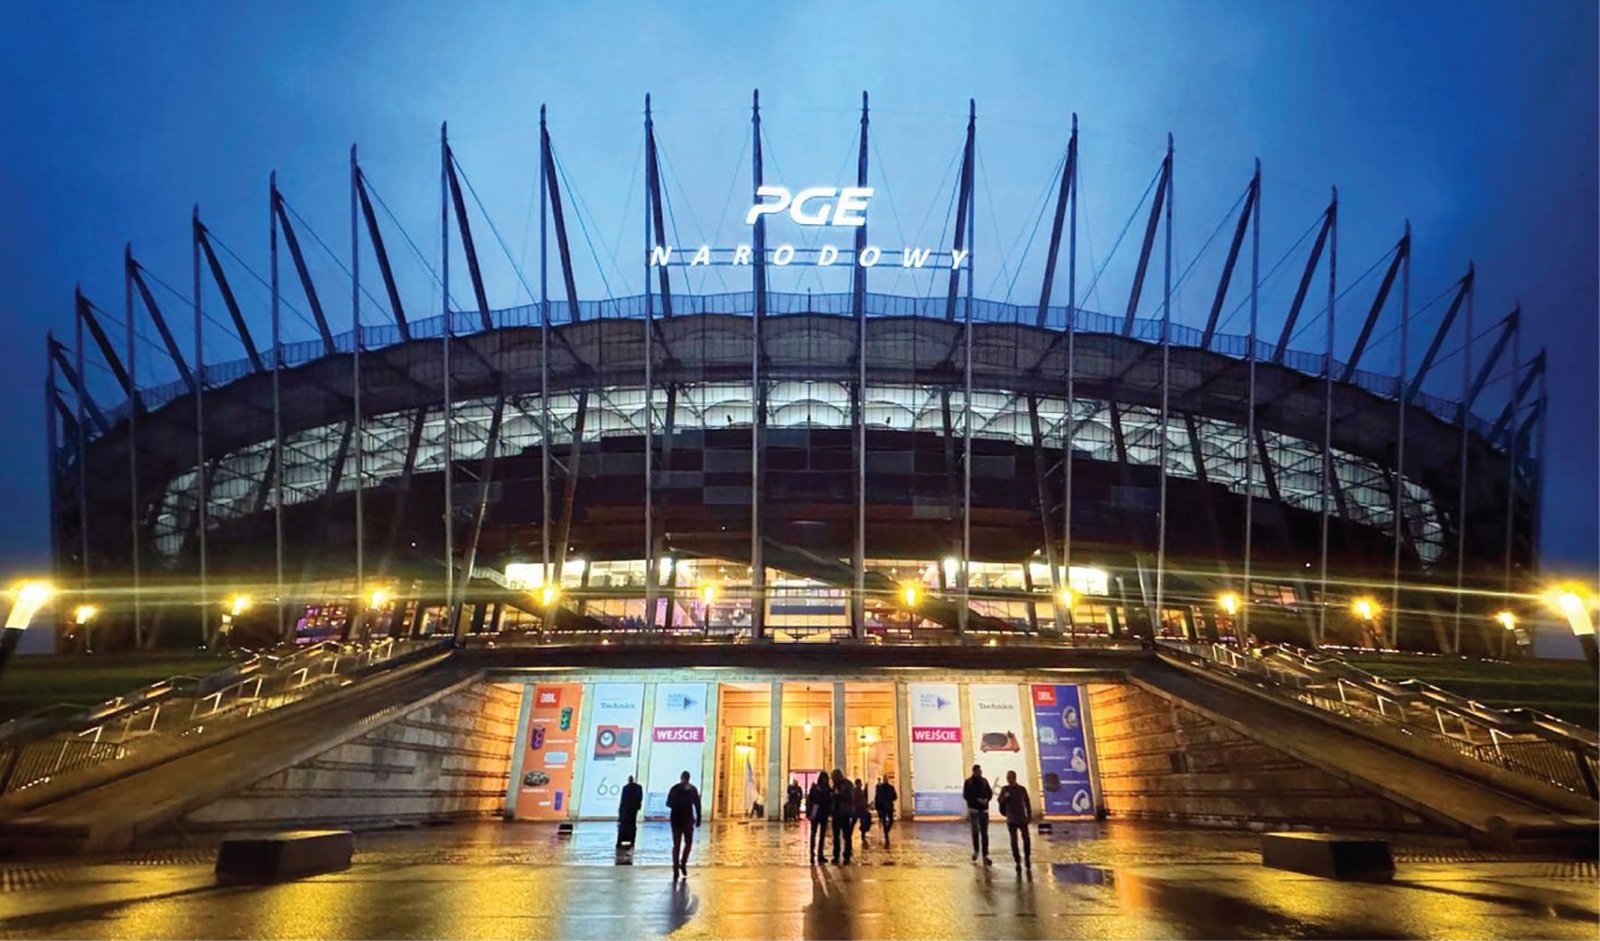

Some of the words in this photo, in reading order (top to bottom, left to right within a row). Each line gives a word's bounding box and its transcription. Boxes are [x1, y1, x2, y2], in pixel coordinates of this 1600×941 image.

[745, 186, 875, 226] PGE
[649, 245, 969, 270] NARODOWY
[1037, 691, 1054, 701] JBL
[600, 701, 636, 709] Technics
[978, 702, 1014, 710] Technics
[656, 729, 700, 741] WEJŚCIE
[914, 729, 957, 741] WEJŚCIE
